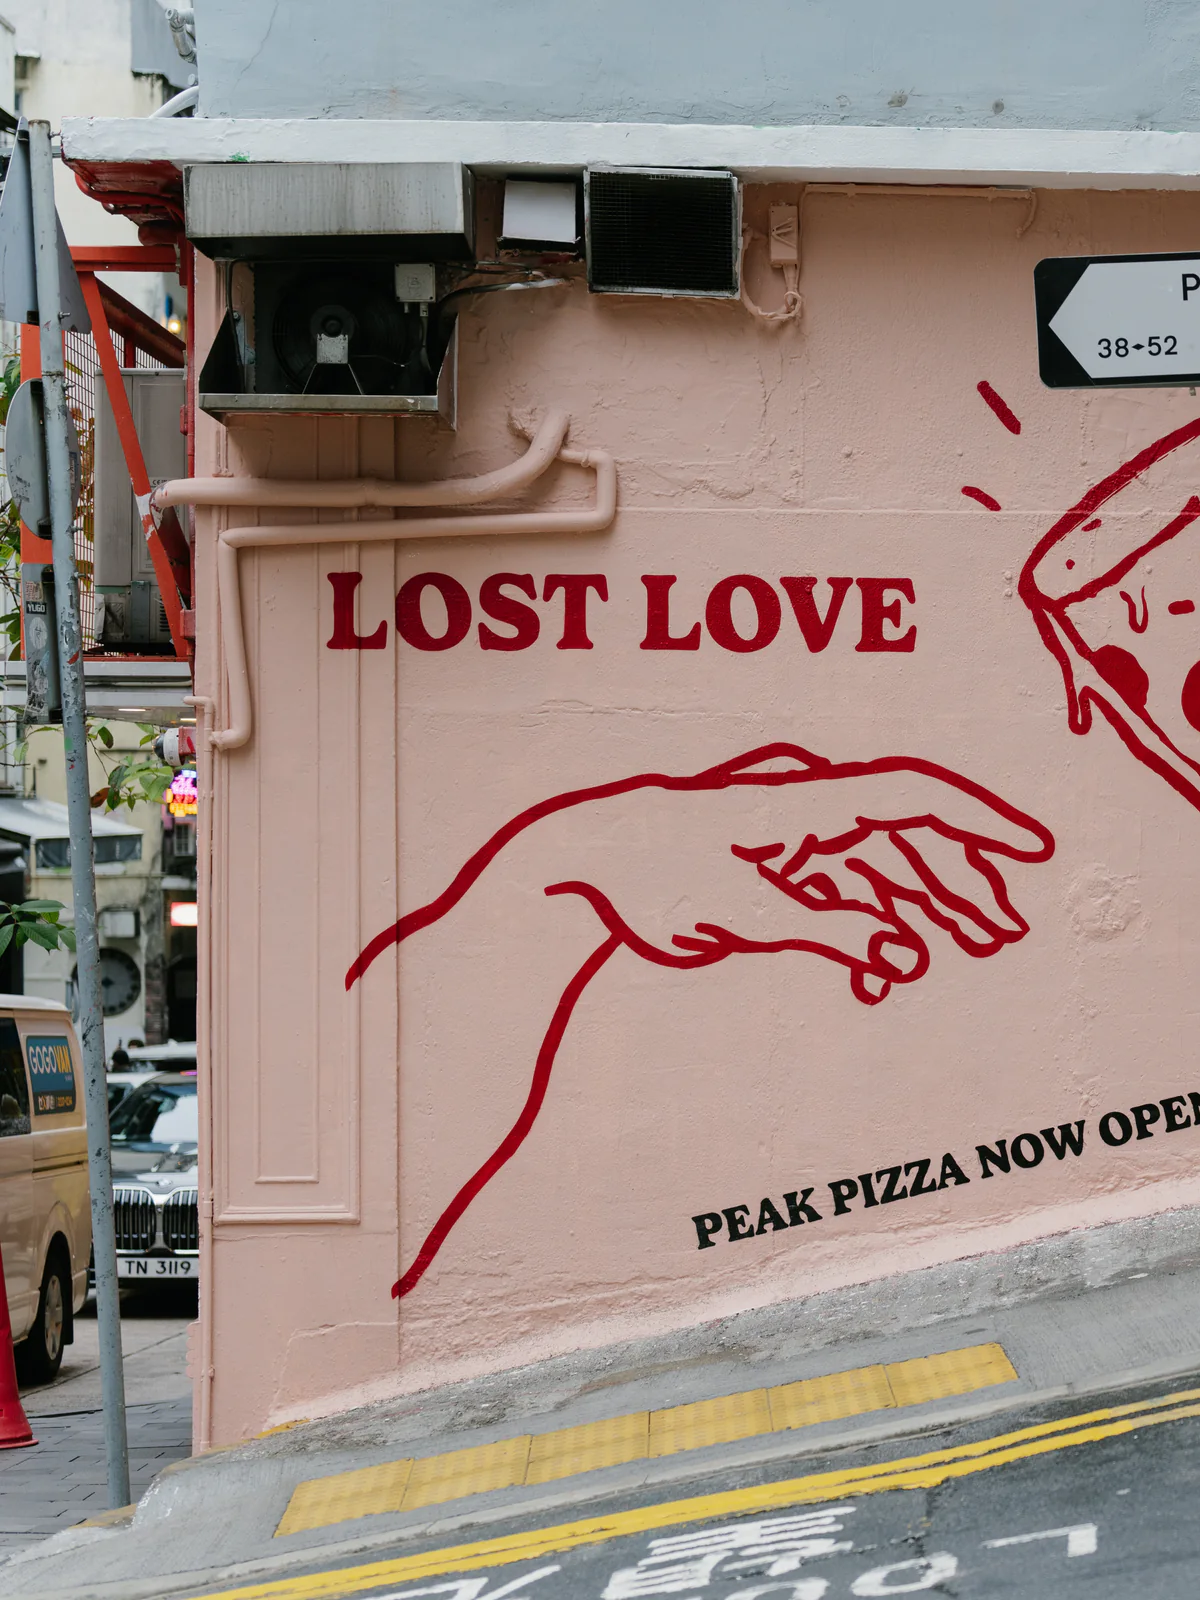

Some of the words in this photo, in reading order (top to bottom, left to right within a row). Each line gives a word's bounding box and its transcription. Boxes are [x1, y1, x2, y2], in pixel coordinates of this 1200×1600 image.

[326, 572, 609, 652] LOST
[639, 574, 917, 654] LOVE
[28, 1045, 72, 1075] GOGOVAN
[691, 1178, 823, 1250] PEAK
[827, 1152, 971, 1216] PIZZA
[975, 1119, 1086, 1179] NOW
[125, 1260, 148, 1275] TN
[155, 1259, 191, 1275] 3119
